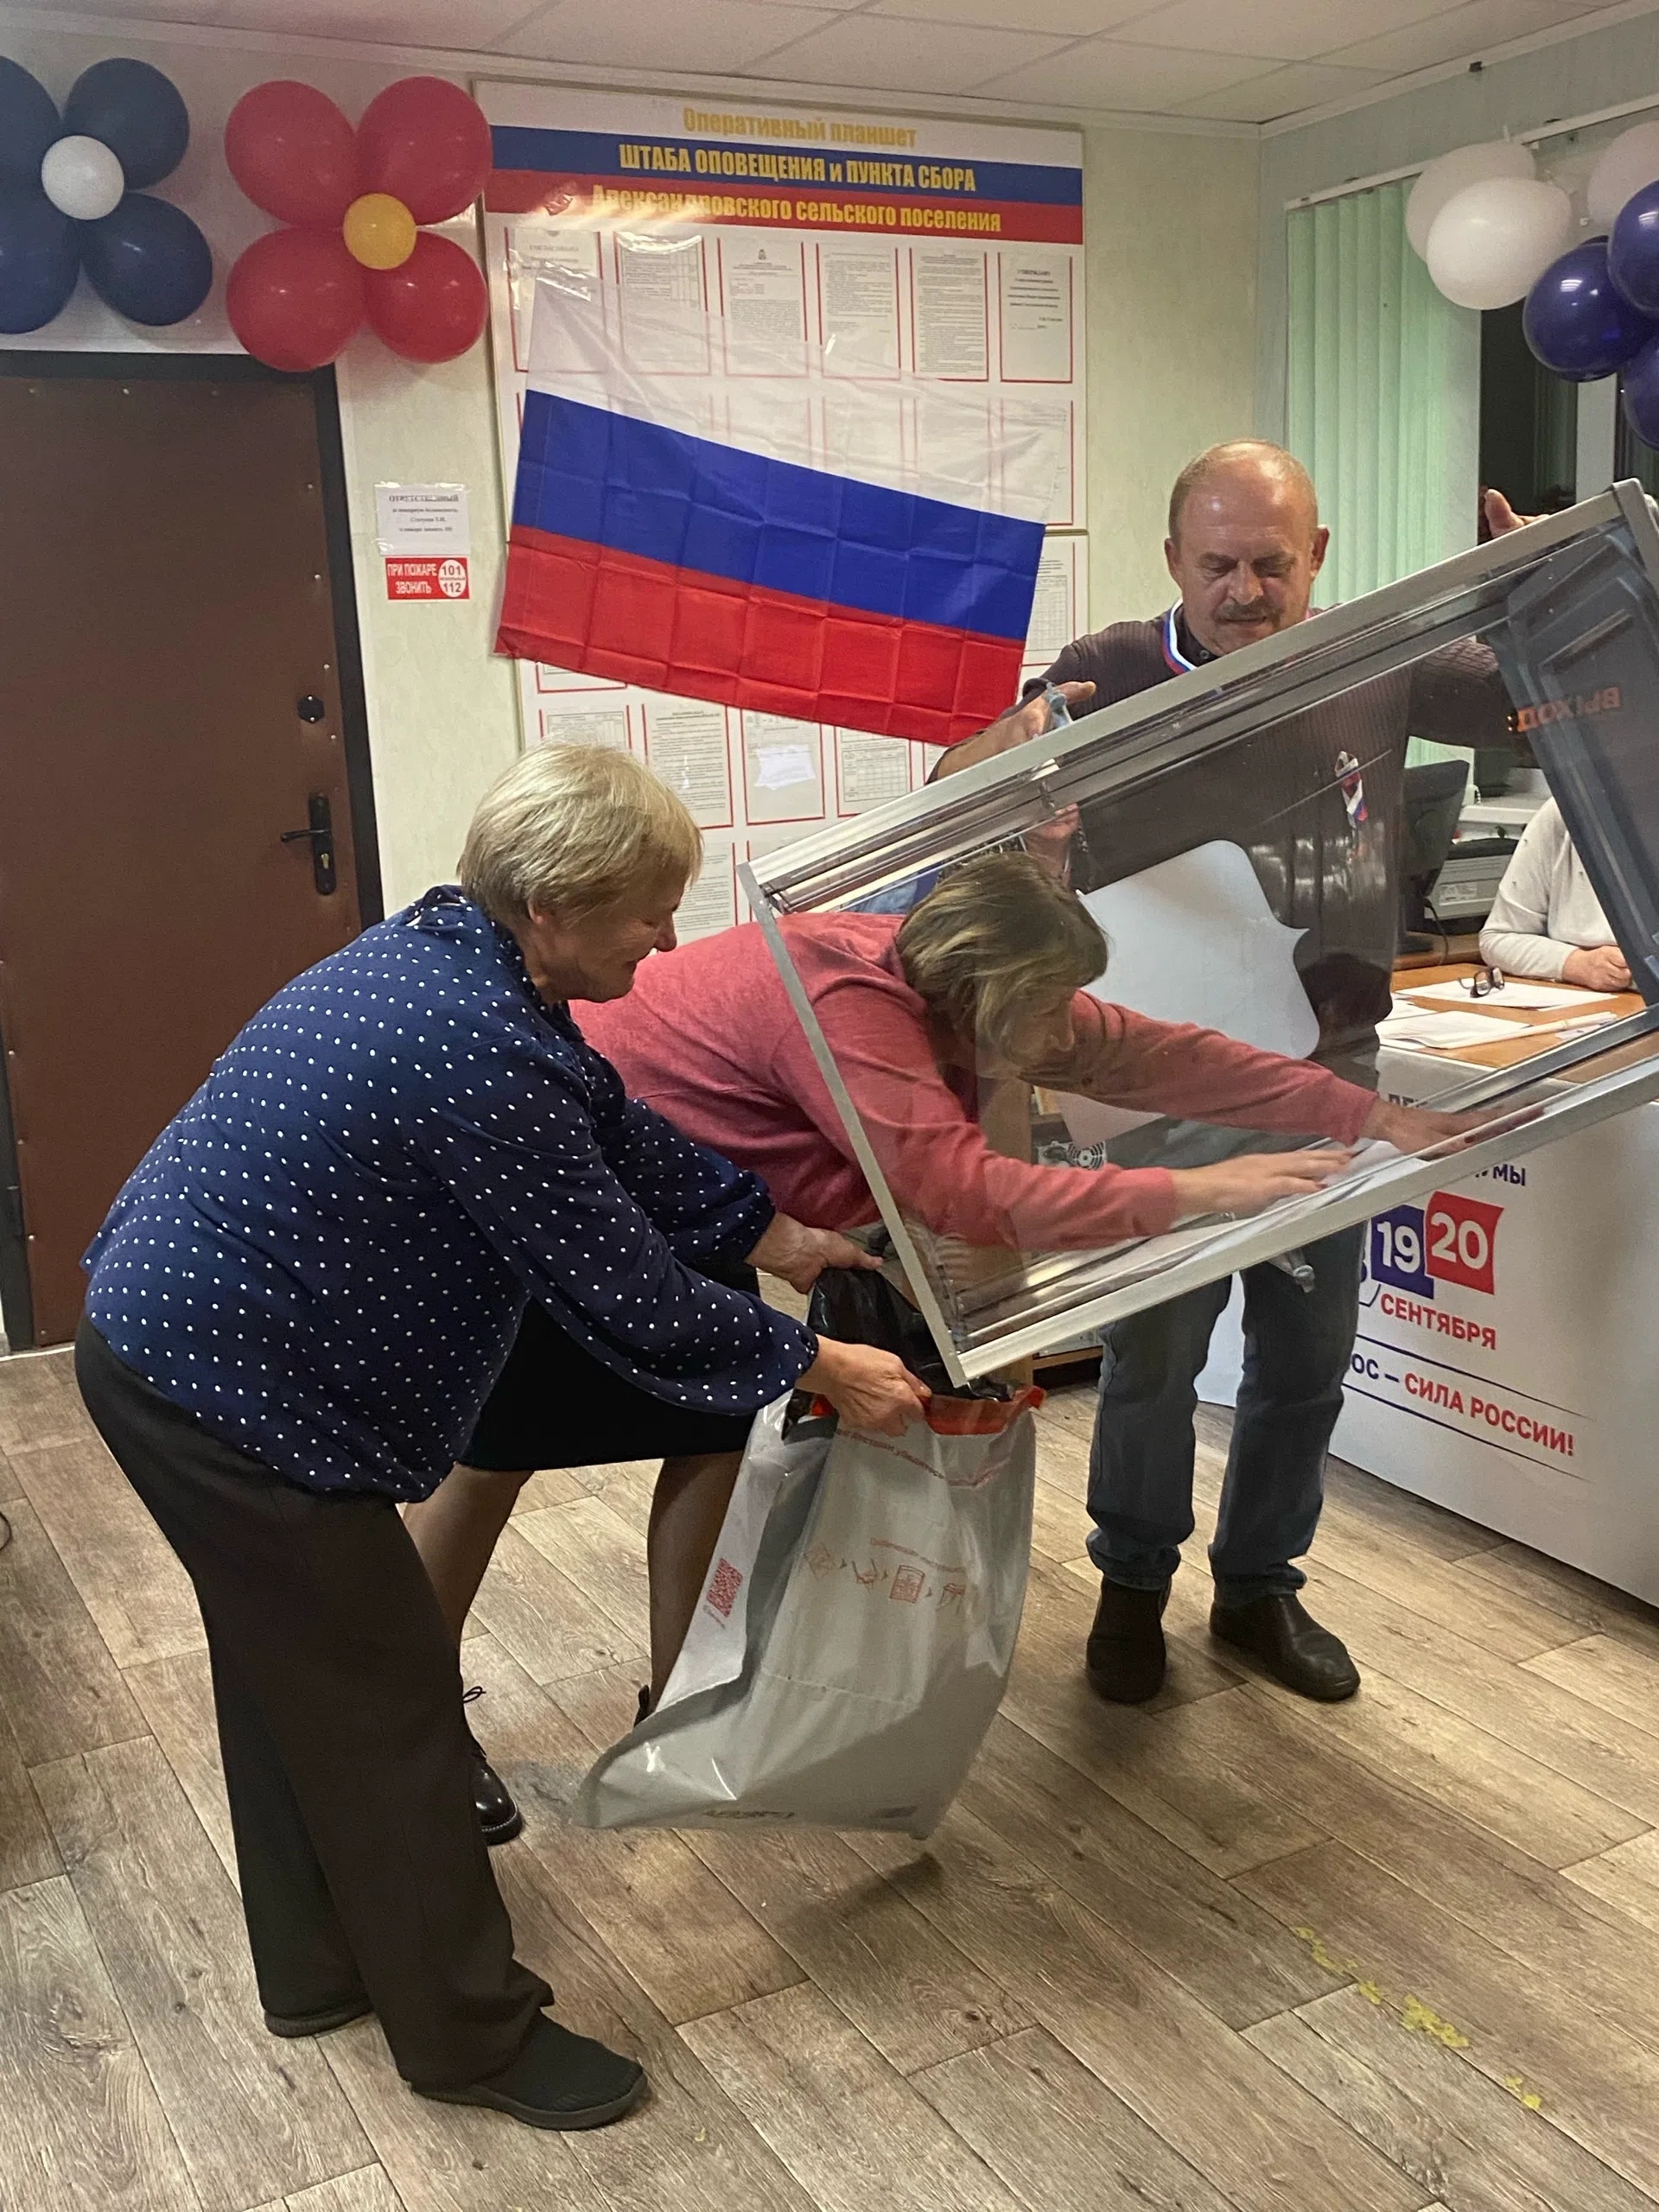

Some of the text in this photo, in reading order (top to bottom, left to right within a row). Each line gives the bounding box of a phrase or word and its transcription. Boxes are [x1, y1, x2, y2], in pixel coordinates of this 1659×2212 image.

[683, 107, 916, 148] Оперативный планшет
[620, 143, 976, 192] ШТАБА ОПОВЕЩЕНИЯ и ПУНКТА СБОРА
[797, 201, 897, 226] сельского
[900, 207, 1001, 232] поселения
[395, 581, 432, 594] ЗВОНИТЬ
[442, 564, 461, 575] 101
[443, 582, 461, 593] 112
[1376, 1211, 1489, 1274] 19 20
[1380, 1293, 1497, 1351] СЕНТЯБРЯ
[1404, 1372, 1465, 1414] СИЛА
[1470, 1395, 1575, 1457] РОССИИ!
